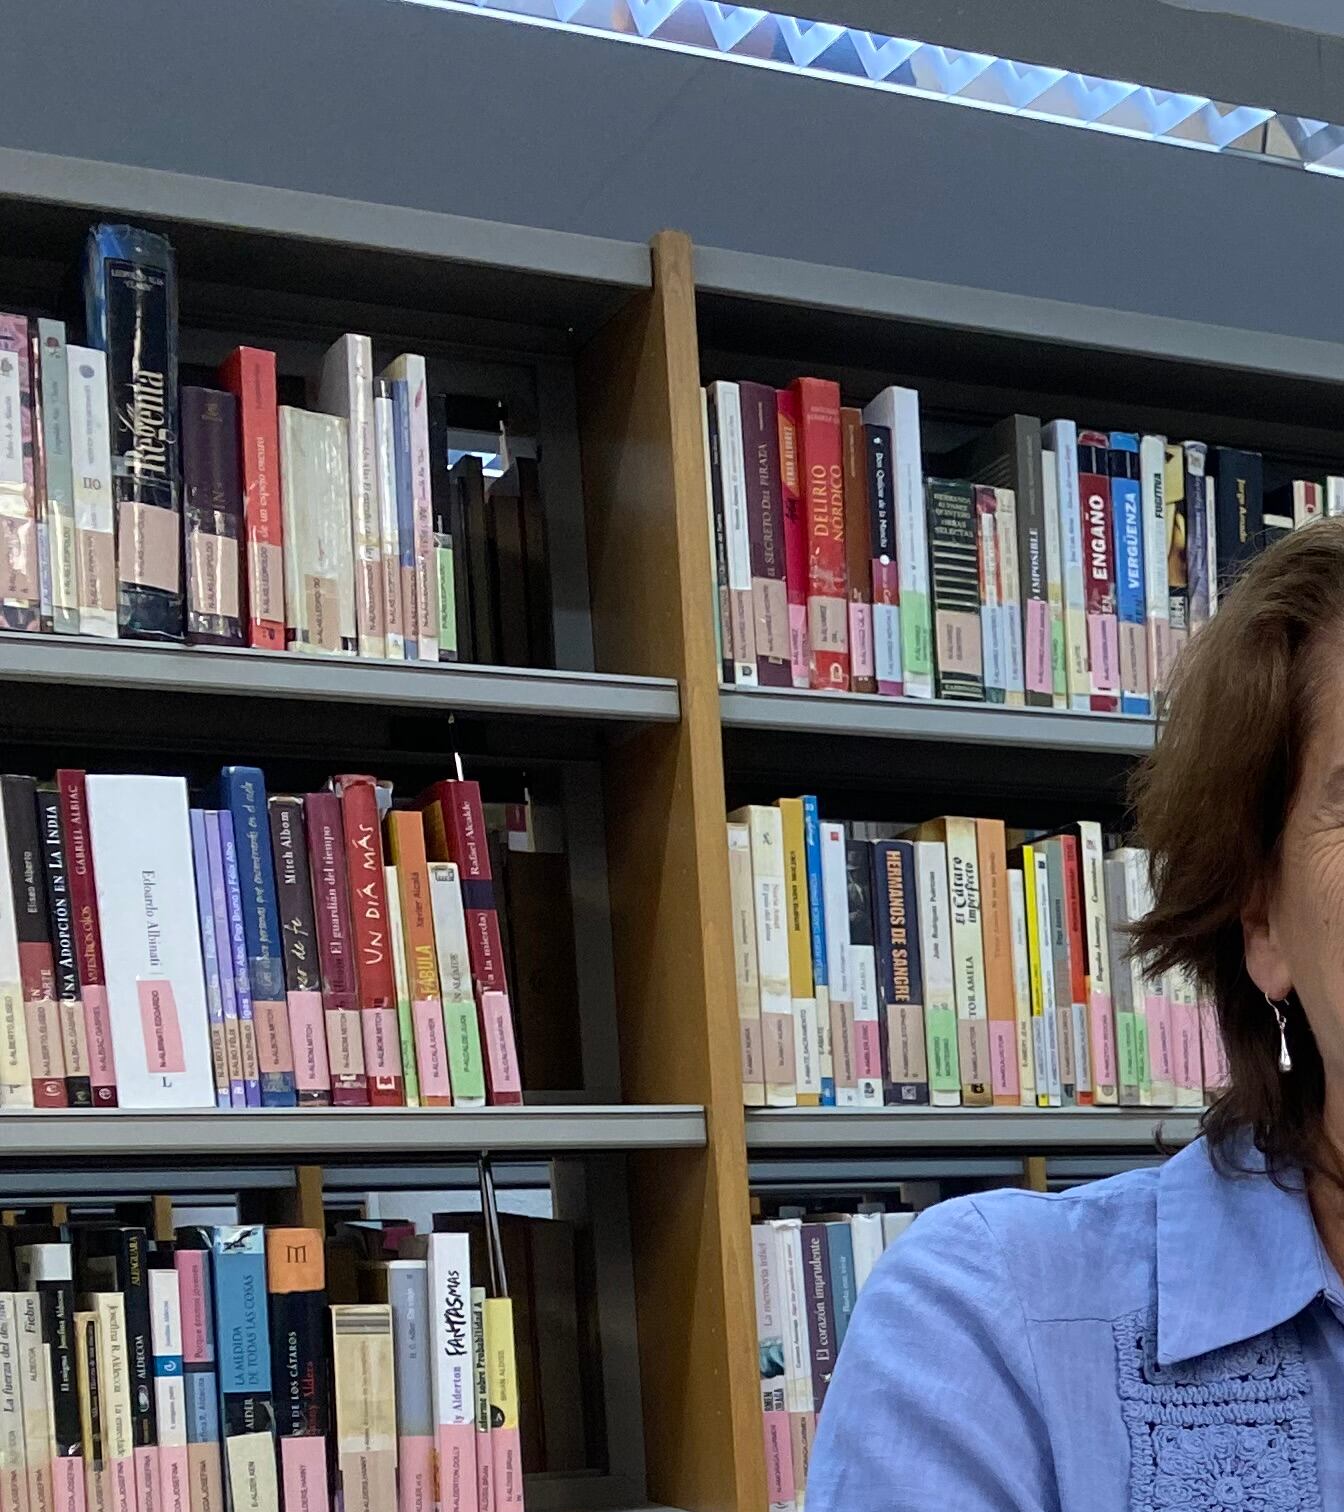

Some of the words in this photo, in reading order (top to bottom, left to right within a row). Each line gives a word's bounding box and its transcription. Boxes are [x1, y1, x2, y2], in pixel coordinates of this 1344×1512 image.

[811, 464, 828, 537] DELIRIO
[1154, 473, 1162, 519] FUGITIVA
[1086, 495, 1108, 581] ENGAÑO
[1124, 492, 1140, 590] VERGÜENZA
[46, 805, 60, 845] INDIA
[280, 810, 293, 848] Albom
[352, 823, 378, 871] MÁS
[284, 851, 296, 885] Mitch
[470, 839, 481, 875] Rafael
[142, 869, 158, 919] Edoardo
[357, 883, 379, 920] DÍA
[886, 850, 905, 924] HERMANOS
[57, 899, 74, 974] ADOPCIÓN
[366, 931, 383, 965] UN
[808, 1237, 826, 1298] imprudente
[24, 1298, 35, 1335] Fiebre
[444, 1270, 468, 1357] FANTASMAS
[812, 1299, 830, 1344] corazón
[137, 1334, 146, 1379] ALDECOA
[233, 1325, 243, 1369] MEDIDA
[453, 1366, 463, 1408] Alderton
